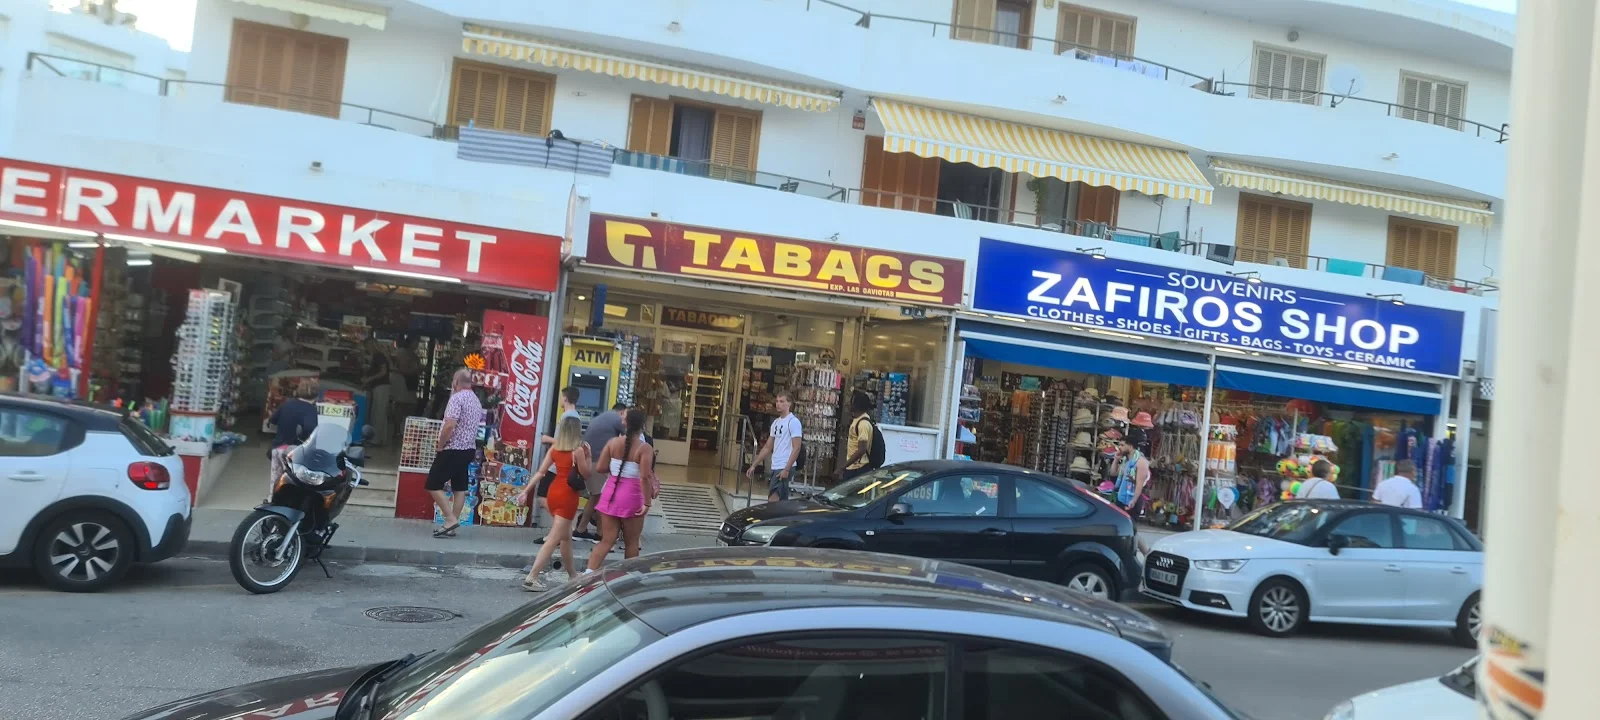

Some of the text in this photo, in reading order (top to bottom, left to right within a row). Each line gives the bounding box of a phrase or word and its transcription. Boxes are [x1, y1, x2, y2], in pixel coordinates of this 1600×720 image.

[0, 167, 497, 273] ERMARKET
[683, 230, 945, 294] TABACS
[863, 288, 895, 297] GAVIOTAS
[1167, 271, 1297, 304] SOUVENIRS
[1027, 270, 1420, 353] ZAFIROS SHOP
[1027, 305, 1416, 369] CLOTHES SHOES GIFTS BAGS TOYS CERAMIC
[505, 335, 543, 426] Coca-Cola
[575, 349, 611, 364] ATM
